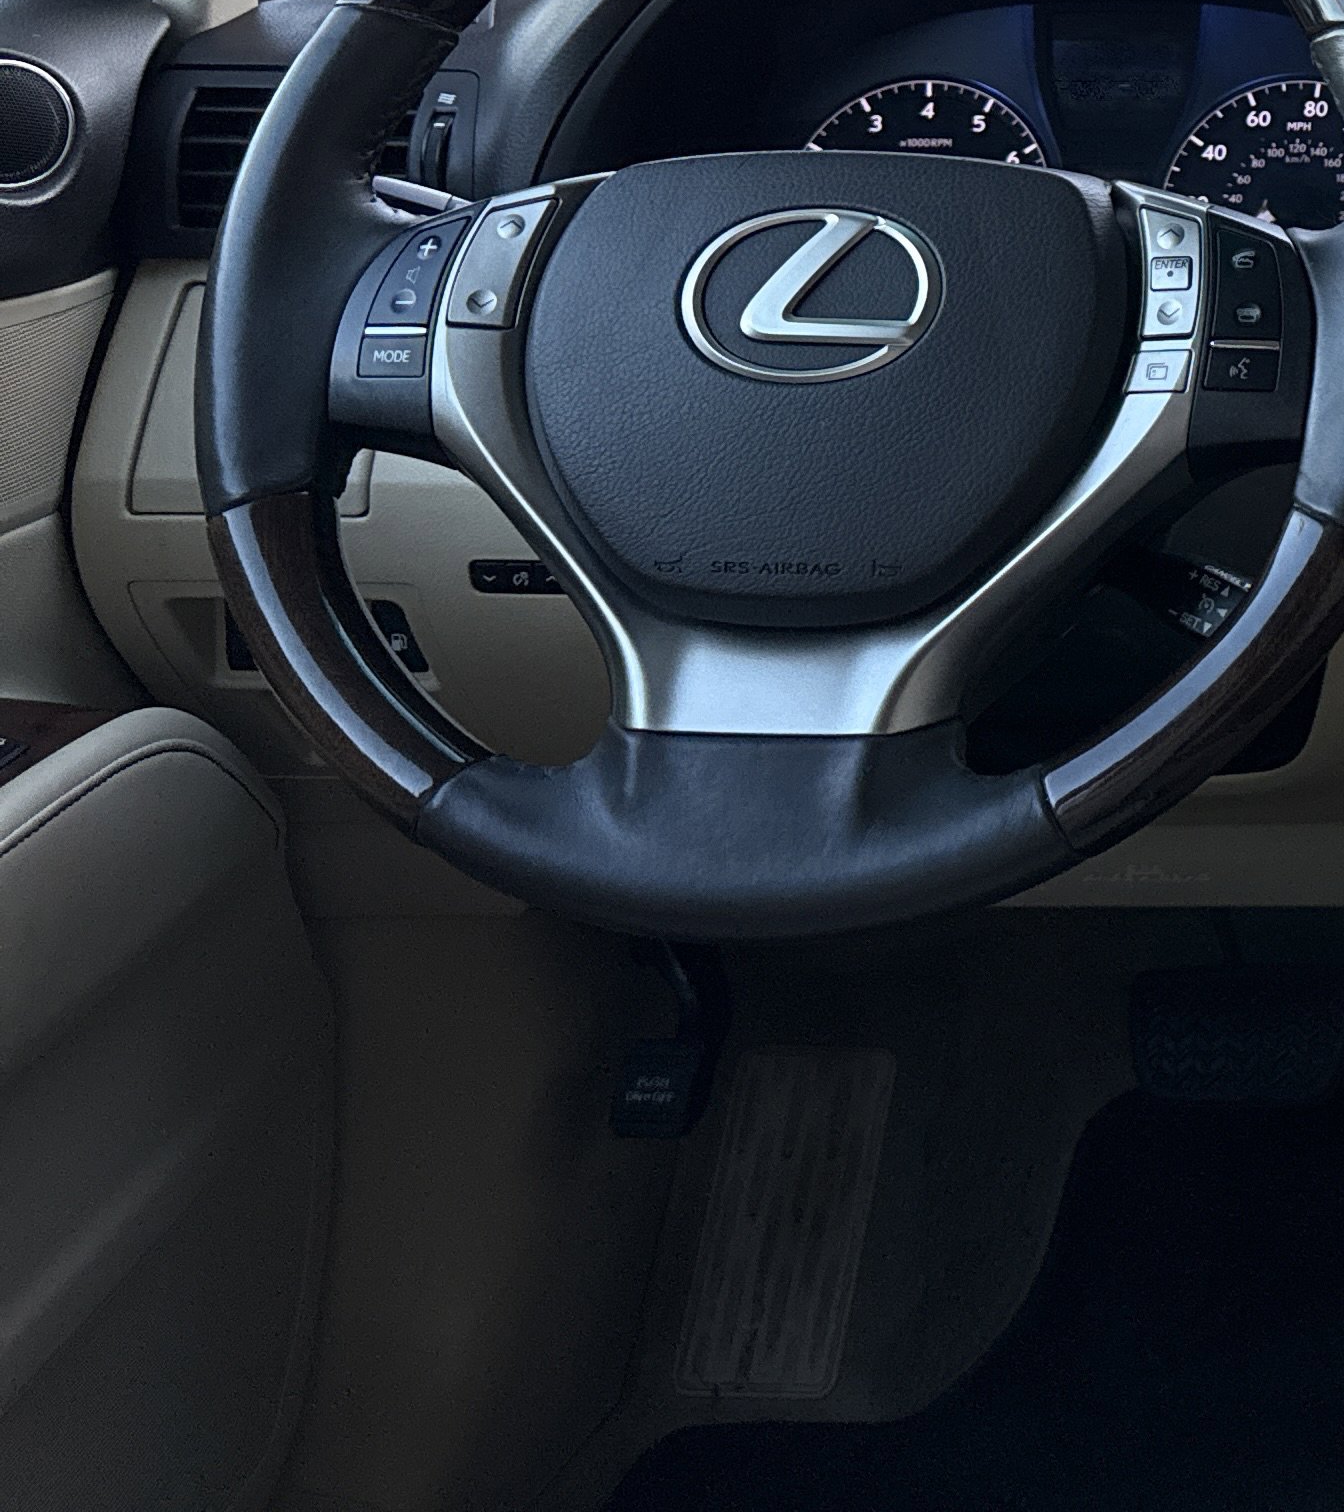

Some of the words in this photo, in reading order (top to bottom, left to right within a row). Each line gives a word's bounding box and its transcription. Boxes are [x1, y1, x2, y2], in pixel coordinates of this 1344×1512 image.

[919, 101, 936, 120] 4
[1303, 100, 1329, 118] 80
[867, 115, 883, 134] 3
[970, 115, 987, 134] 5
[1245, 110, 1272, 128] 60
[1286, 121, 1312, 132] MPH
[1201, 144, 1228, 162] 40
[1266, 148, 1286, 159] 100
[1288, 143, 1308, 154] 120
[1310, 147, 1328, 158] 140
[1004, 150, 1021, 164] 6
[1250, 159, 1266, 169] 80
[1323, 158, 1342, 169] 160
[1236, 175, 1252, 186] 60
[1228, 193, 1244, 204] 40
[372, 347, 412, 365] MODE
